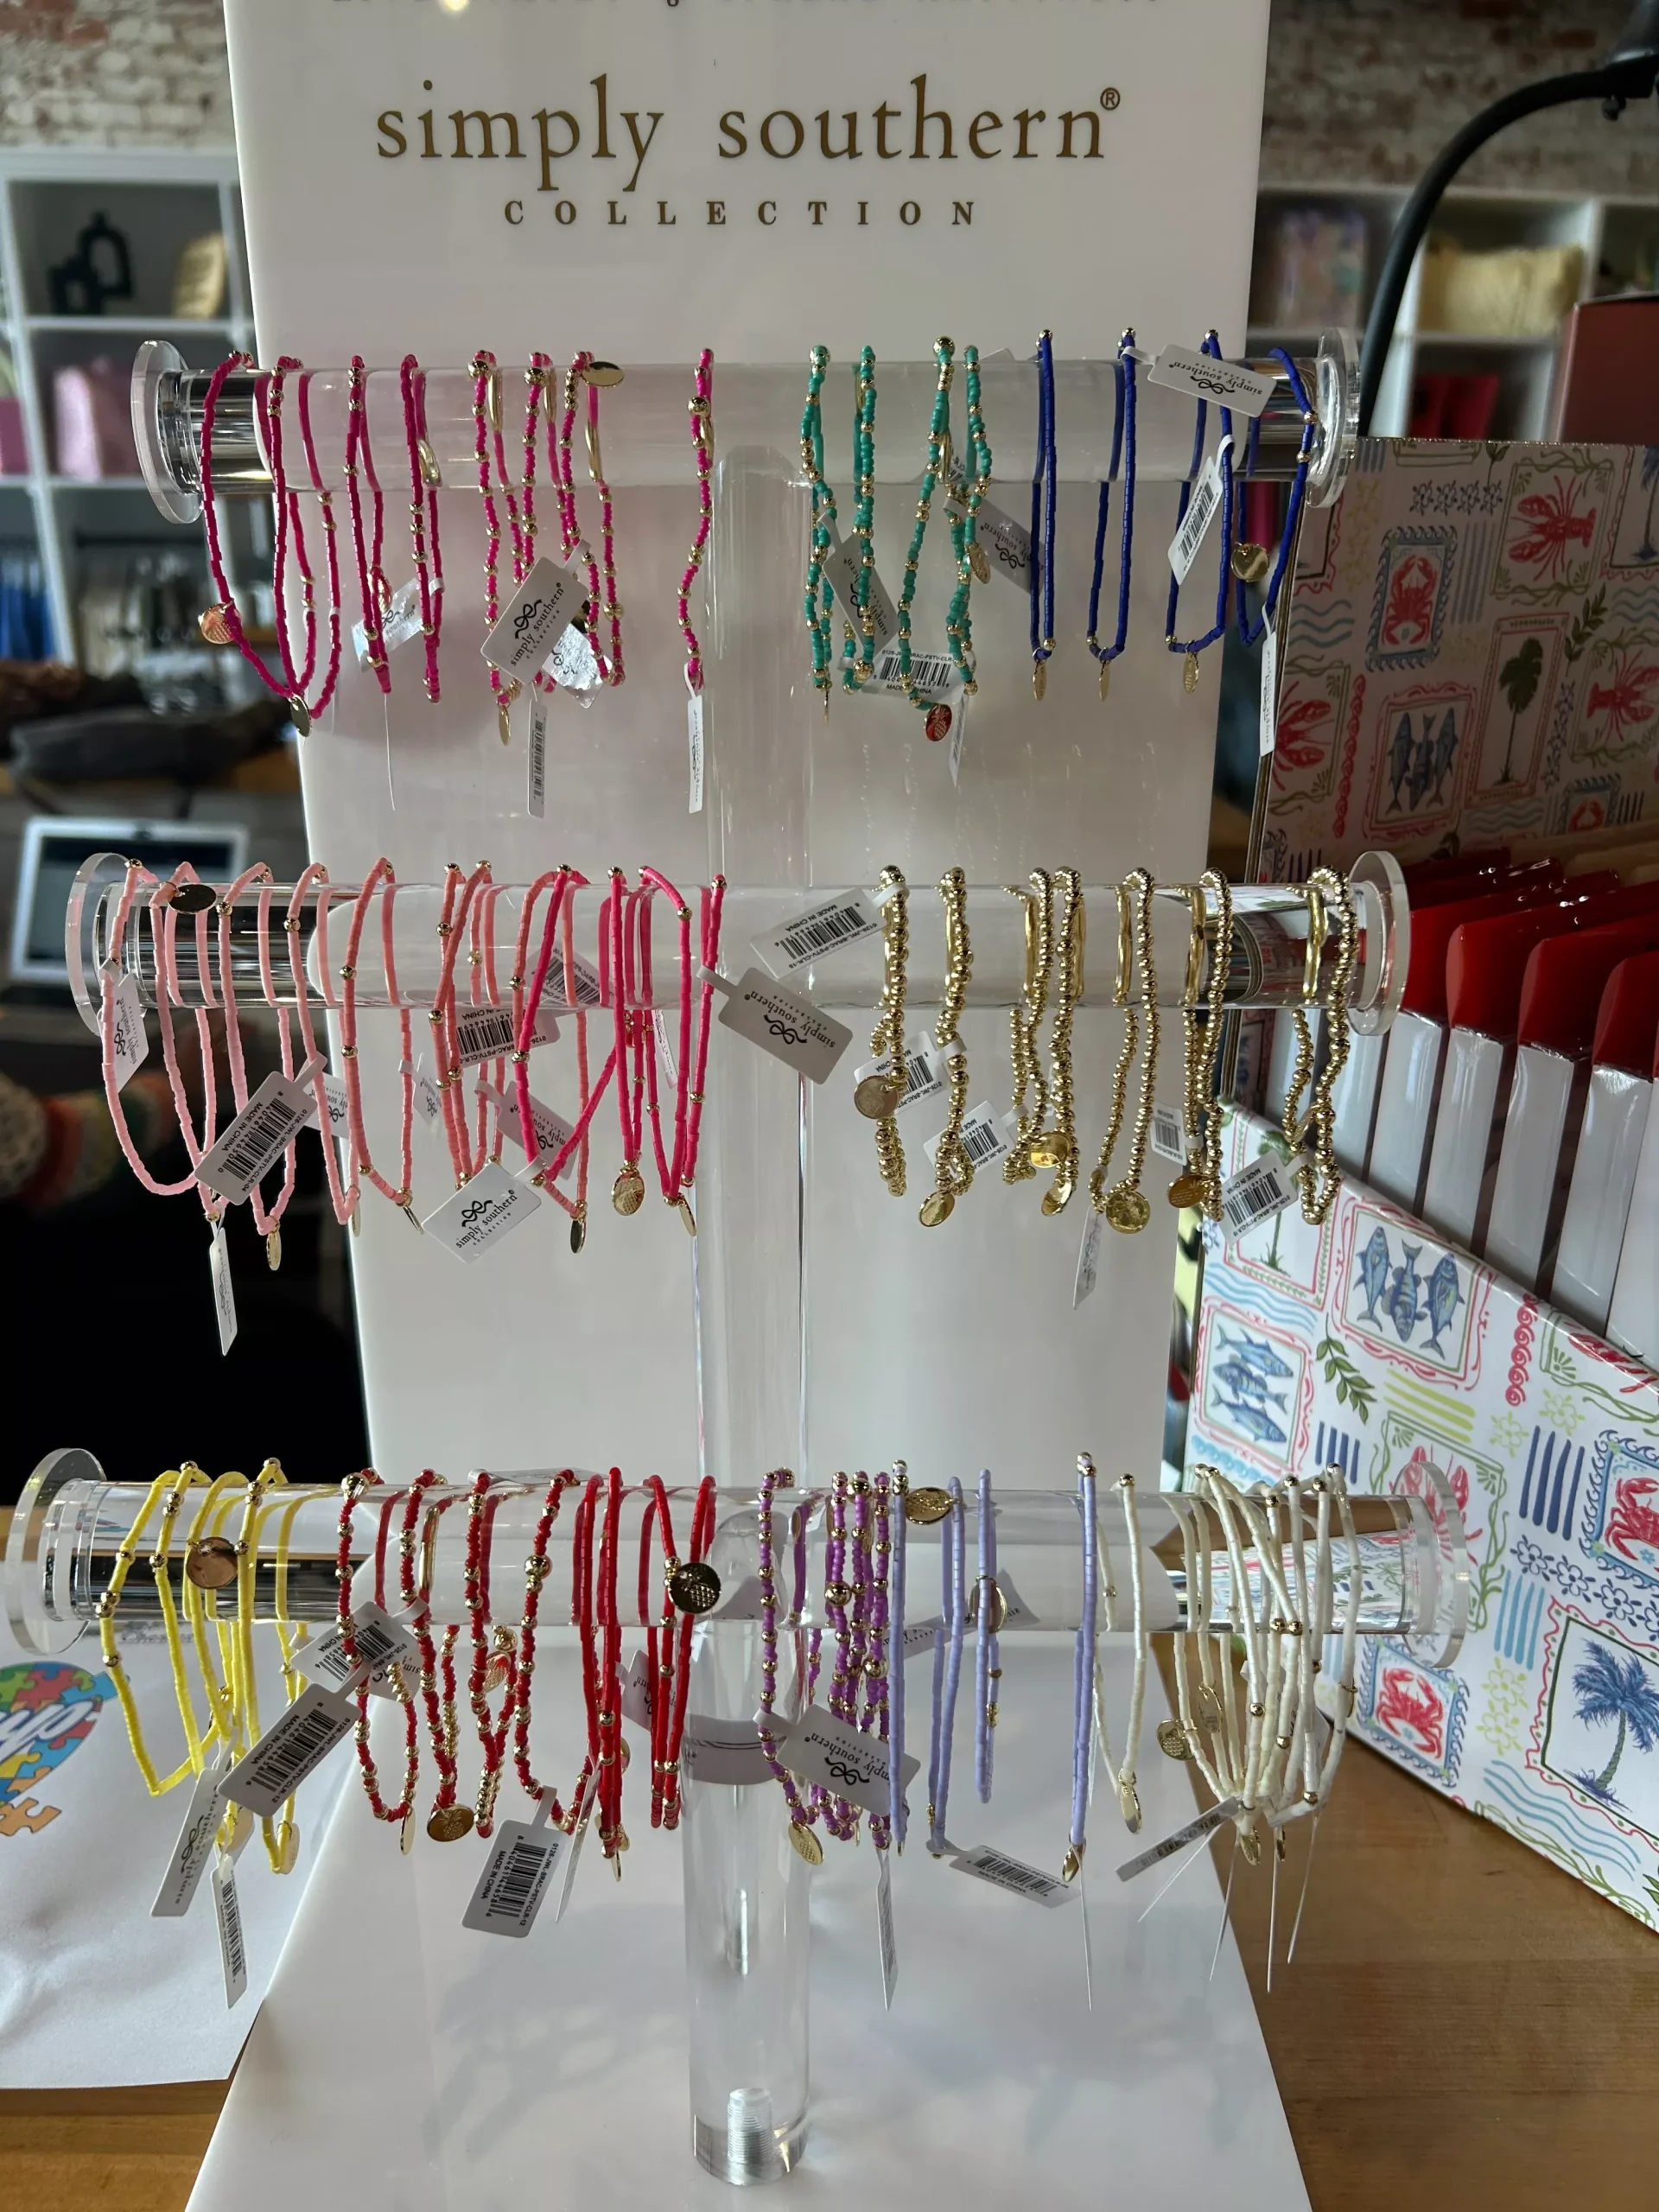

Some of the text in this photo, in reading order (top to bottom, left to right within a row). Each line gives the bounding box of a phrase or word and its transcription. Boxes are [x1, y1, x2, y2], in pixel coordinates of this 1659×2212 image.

[376, 73, 663, 191] simply
[505, 200, 976, 226] COLLECTION
[1226, 378, 1262, 395] simply
[511, 633, 536, 666] simply
[816, 904, 838, 918] MADE
[785, 918, 808, 932] CHINA
[461, 1009, 486, 1020] CHINA
[800, 1020, 836, 1048] simply
[875, 1060, 891, 1072] CHINA
[221, 1102, 264, 1152] MADE IN CHINA
[251, 1106, 272, 1131] 40461
[963, 1118, 977, 1131] MADE
[228, 1134, 250, 1160] 44650
[1247, 1168, 1262, 1181] MADE
[455, 1225, 484, 1249] simply
[318, 1638, 338, 1652] CHINA
[251, 1714, 300, 1764] MADE IN CHINA
[283, 1718, 309, 1742] 40461
[863, 1760, 890, 1781] mply
[493, 1850, 506, 1871] MADE
[502, 1850, 518, 1876] 40461
[175, 1858, 198, 1905] simply
[480, 1878, 494, 1899] CHINA
[490, 1878, 506, 1904] 44658
[977, 1870, 998, 1880] MADE
[1006, 1881, 1027, 1893] CHINA
